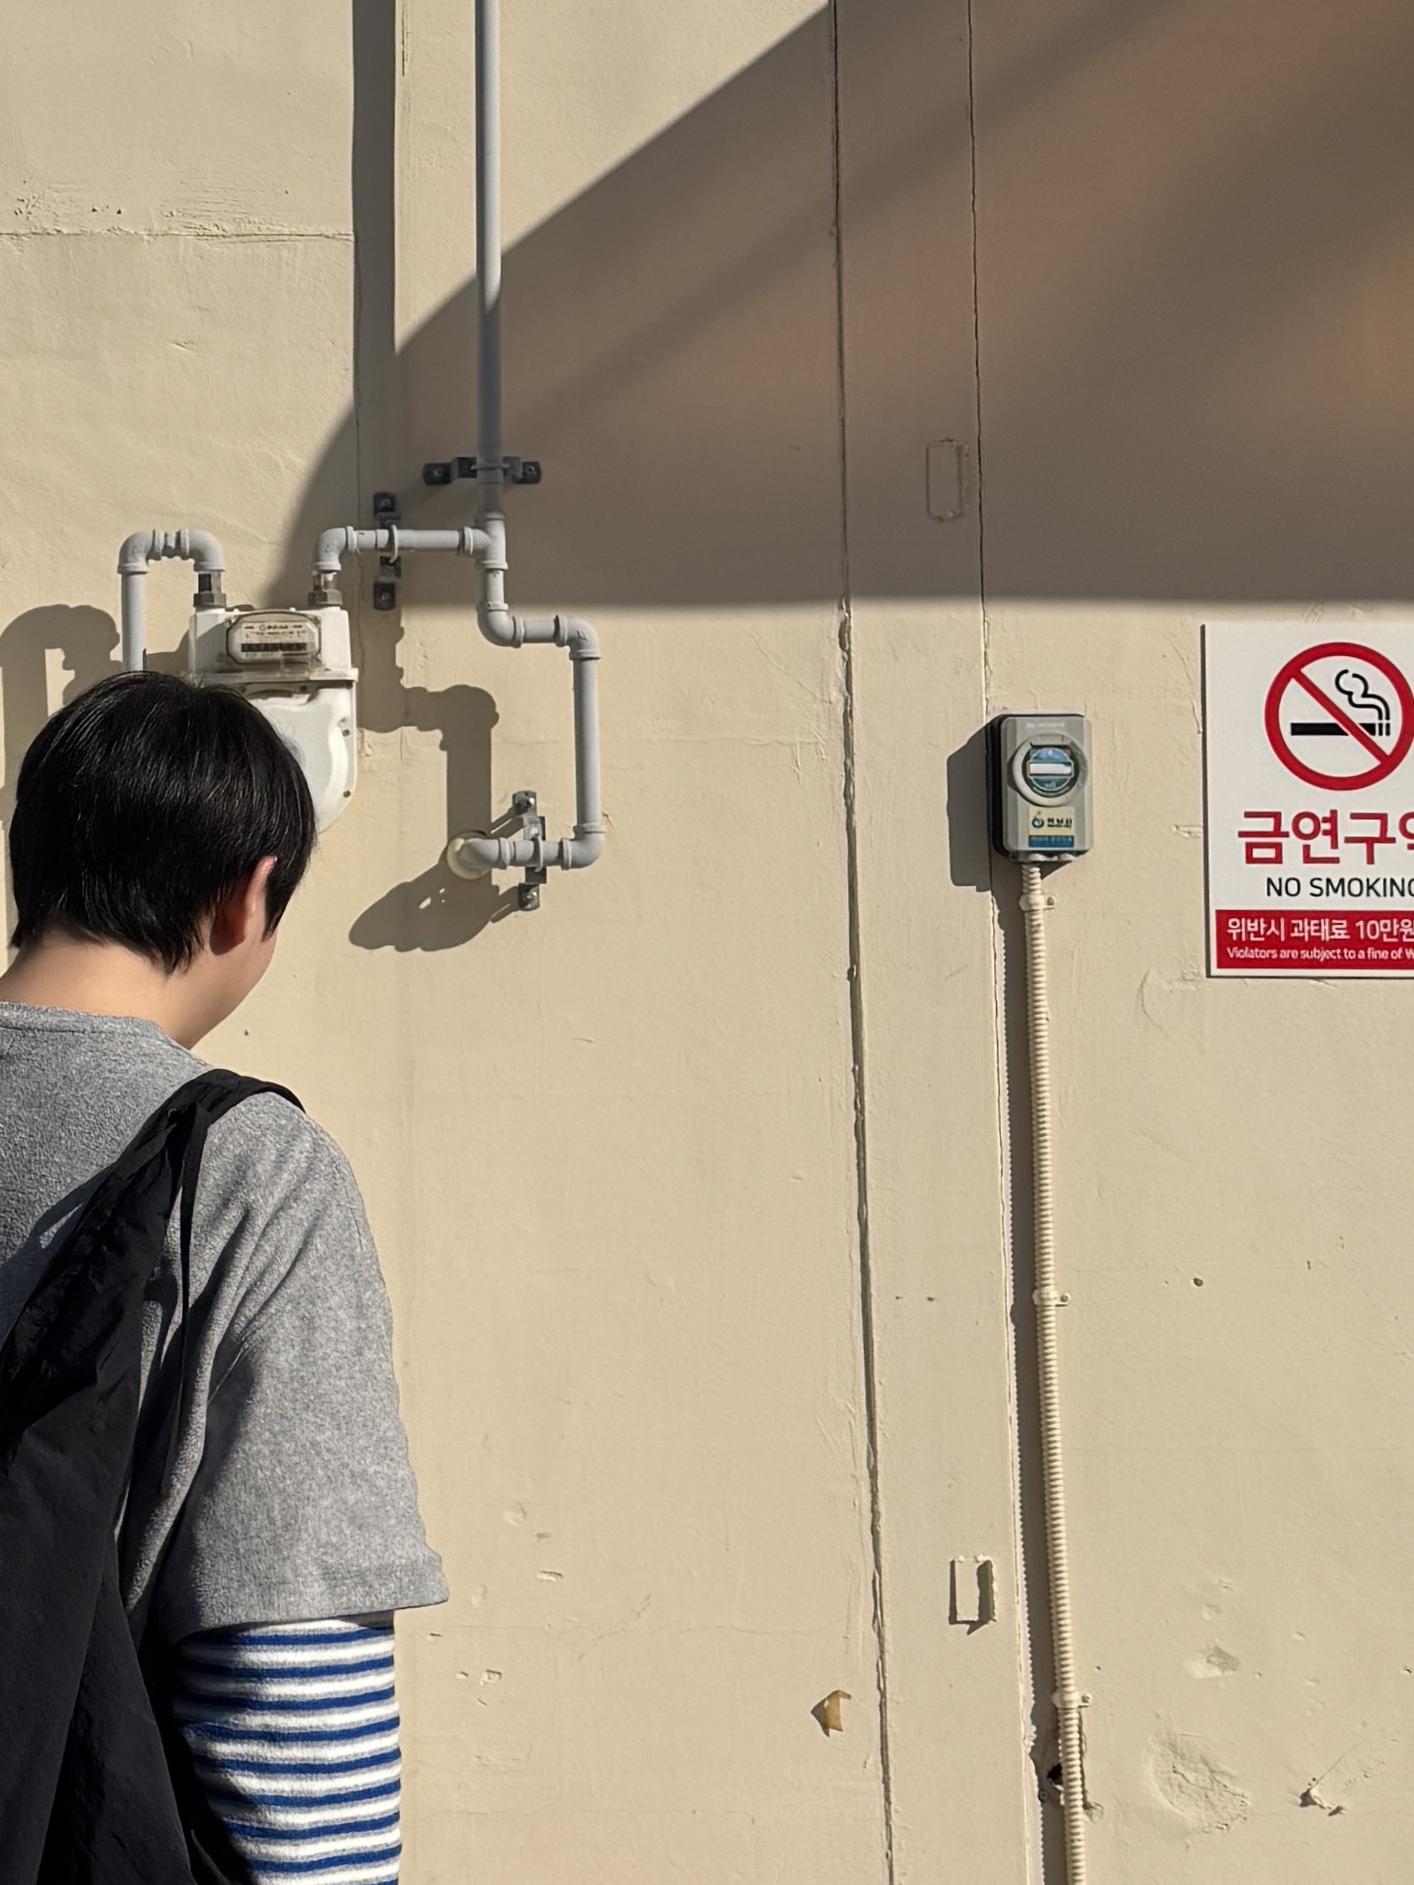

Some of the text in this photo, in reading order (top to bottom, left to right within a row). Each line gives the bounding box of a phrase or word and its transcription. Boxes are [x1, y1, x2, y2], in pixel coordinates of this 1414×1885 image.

[1266, 877, 1301, 897] NO
[1227, 917, 1285, 942] 위반시
[1290, 918, 1350, 942] 과태료
[1227, 946, 1278, 959] Violators
[1280, 949, 1299, 959] are
[1300, 947, 1342, 962] subject
[1343, 948, 1356, 959] to
[1357, 949, 1365, 959] a
[1367, 947, 1389, 959] fine
[1390, 947, 1403, 959] of
